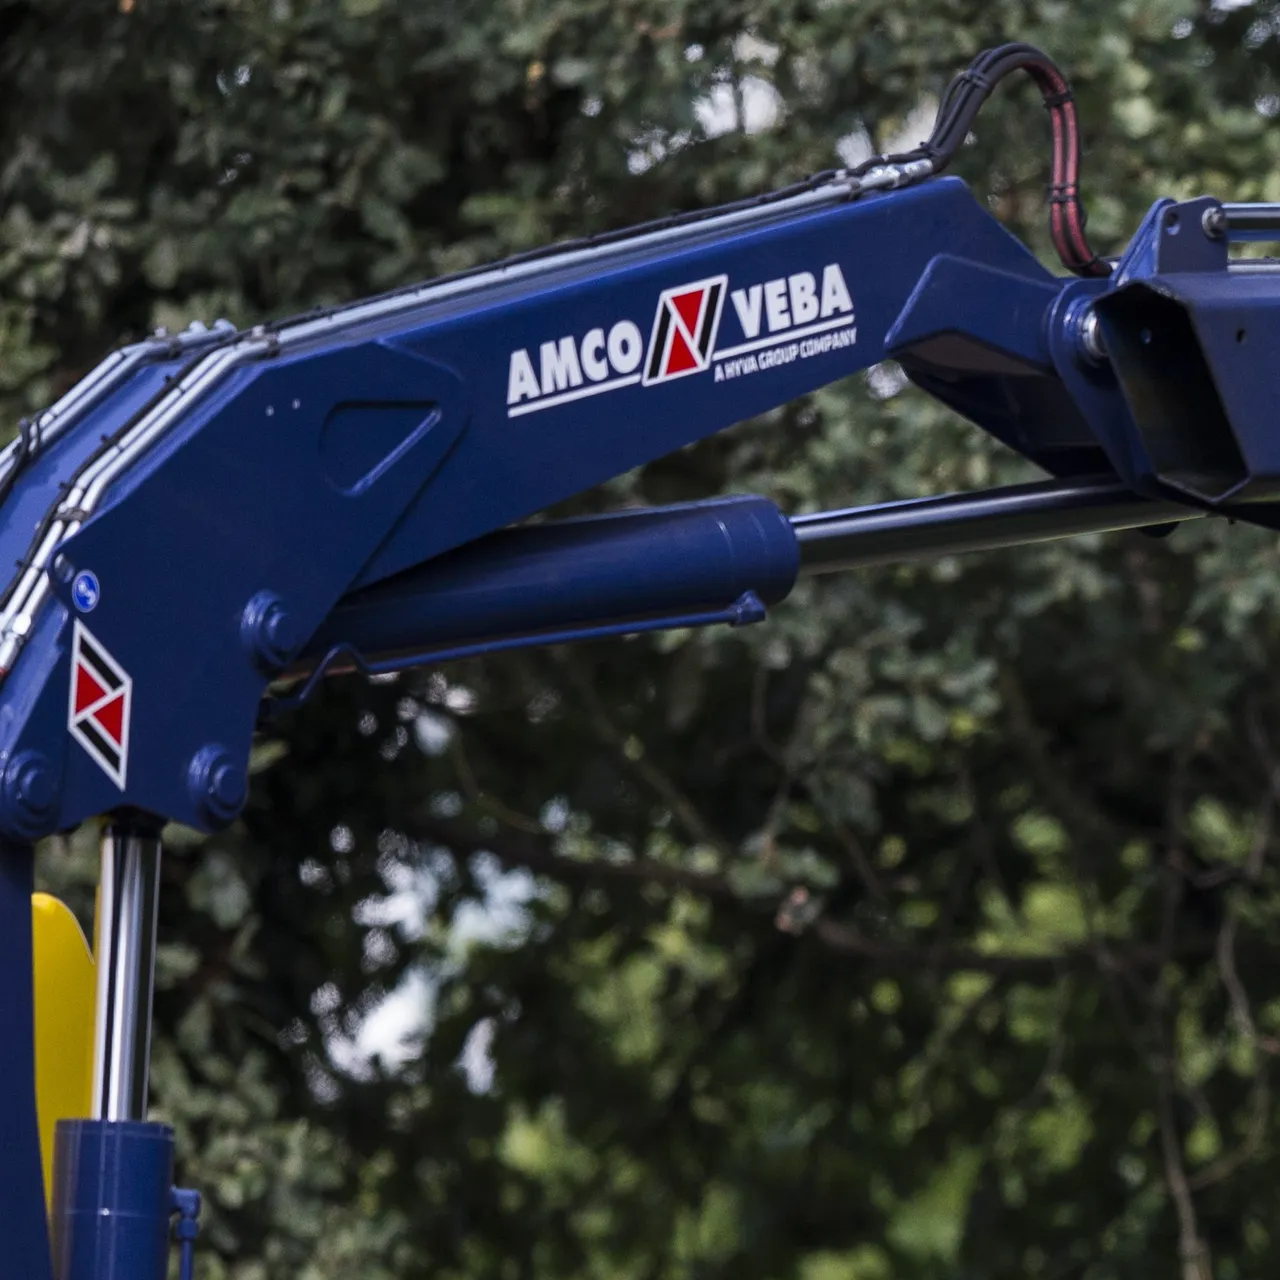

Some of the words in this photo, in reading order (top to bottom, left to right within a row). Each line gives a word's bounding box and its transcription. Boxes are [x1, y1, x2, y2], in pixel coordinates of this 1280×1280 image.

[507, 319, 644, 405] AMCO
[730, 263, 854, 339] VEBA
[714, 363, 725, 383] A
[758, 343, 800, 370] GROUP
[799, 327, 858, 358] COMPANY
